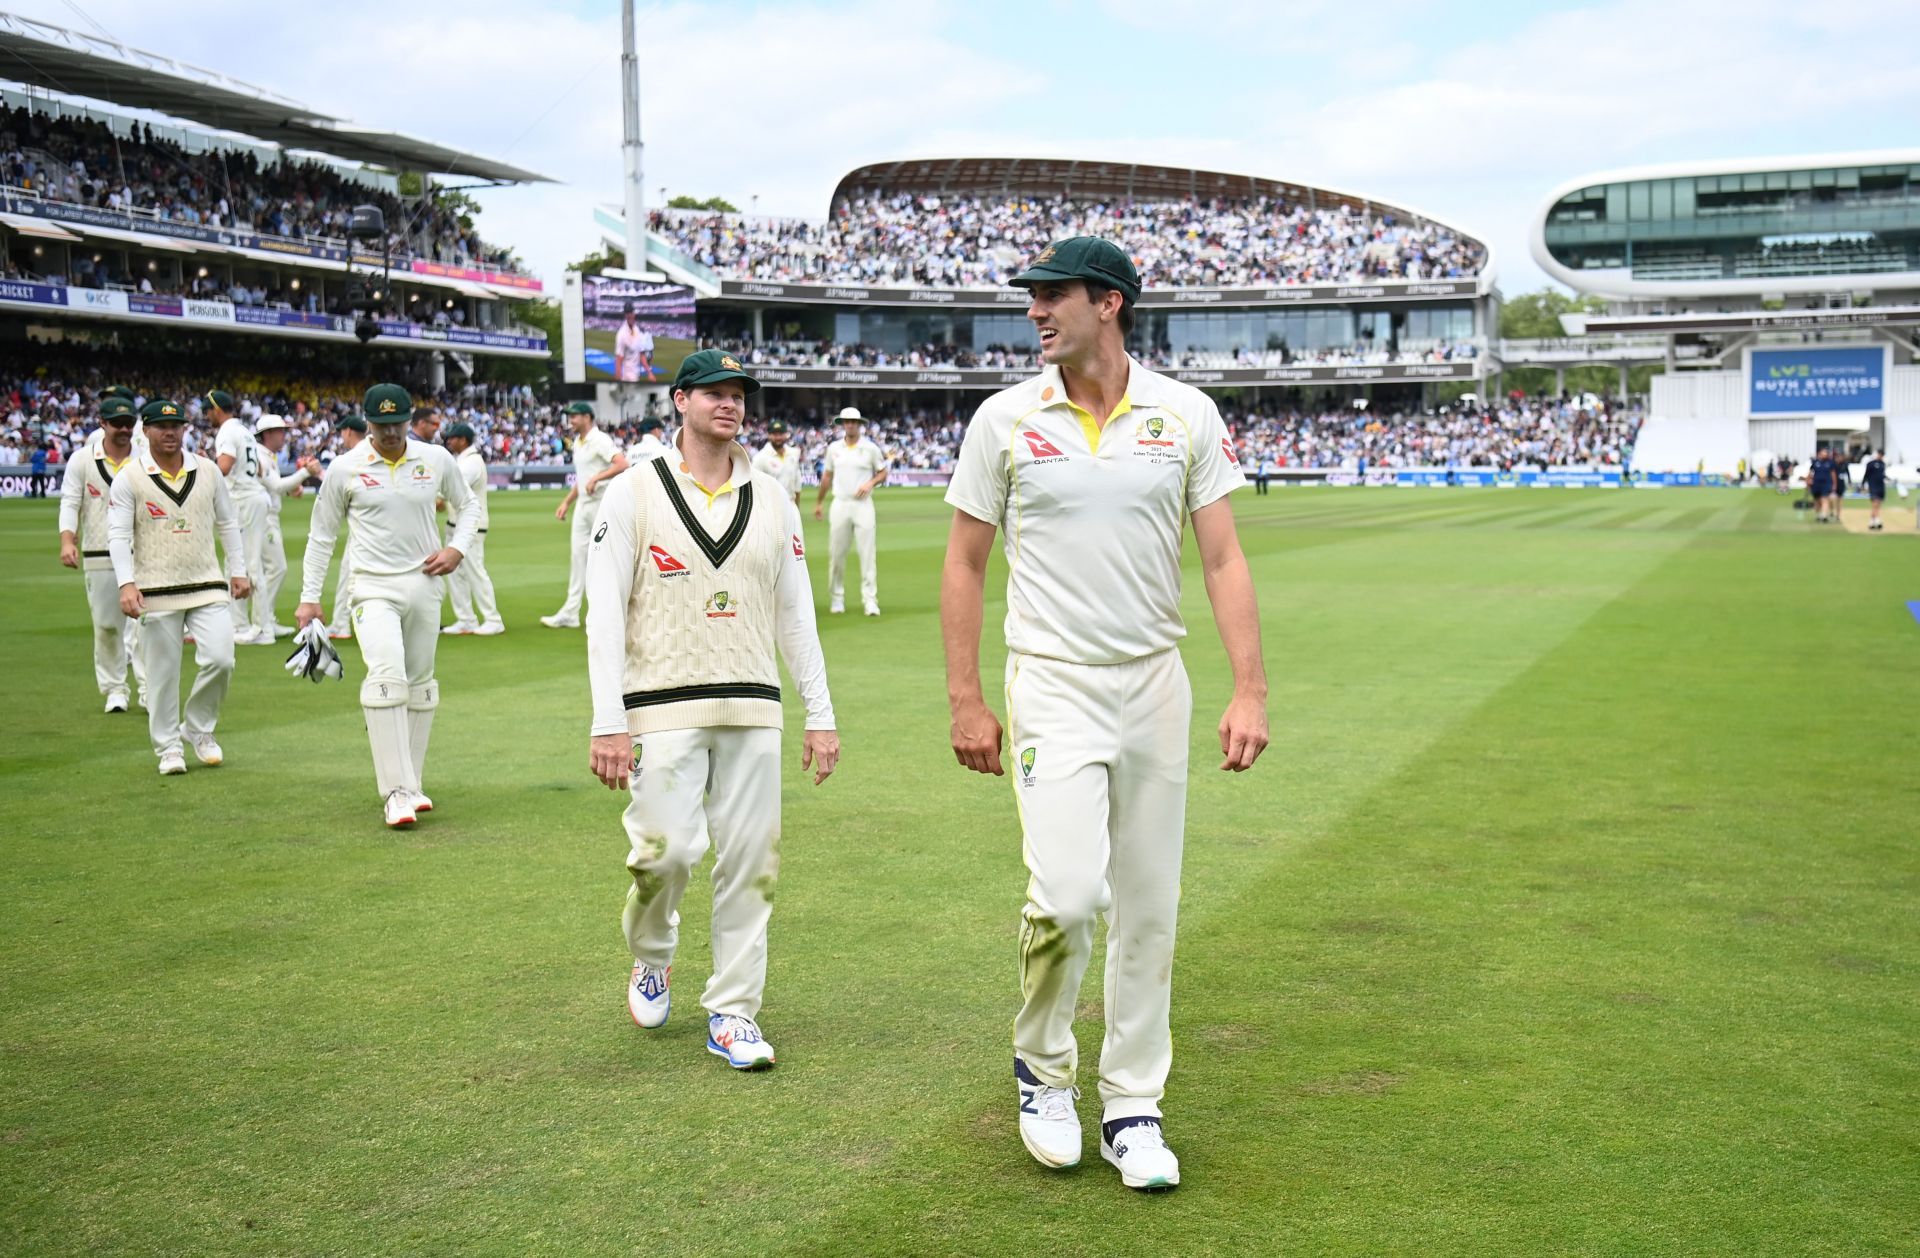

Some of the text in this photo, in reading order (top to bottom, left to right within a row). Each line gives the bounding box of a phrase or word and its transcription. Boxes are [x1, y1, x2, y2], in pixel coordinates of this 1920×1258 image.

[1755, 377, 1880, 392] RUTH STRAUSS
[1034, 456, 1070, 465] QANTAS
[659, 570, 691, 579] QANTAS
